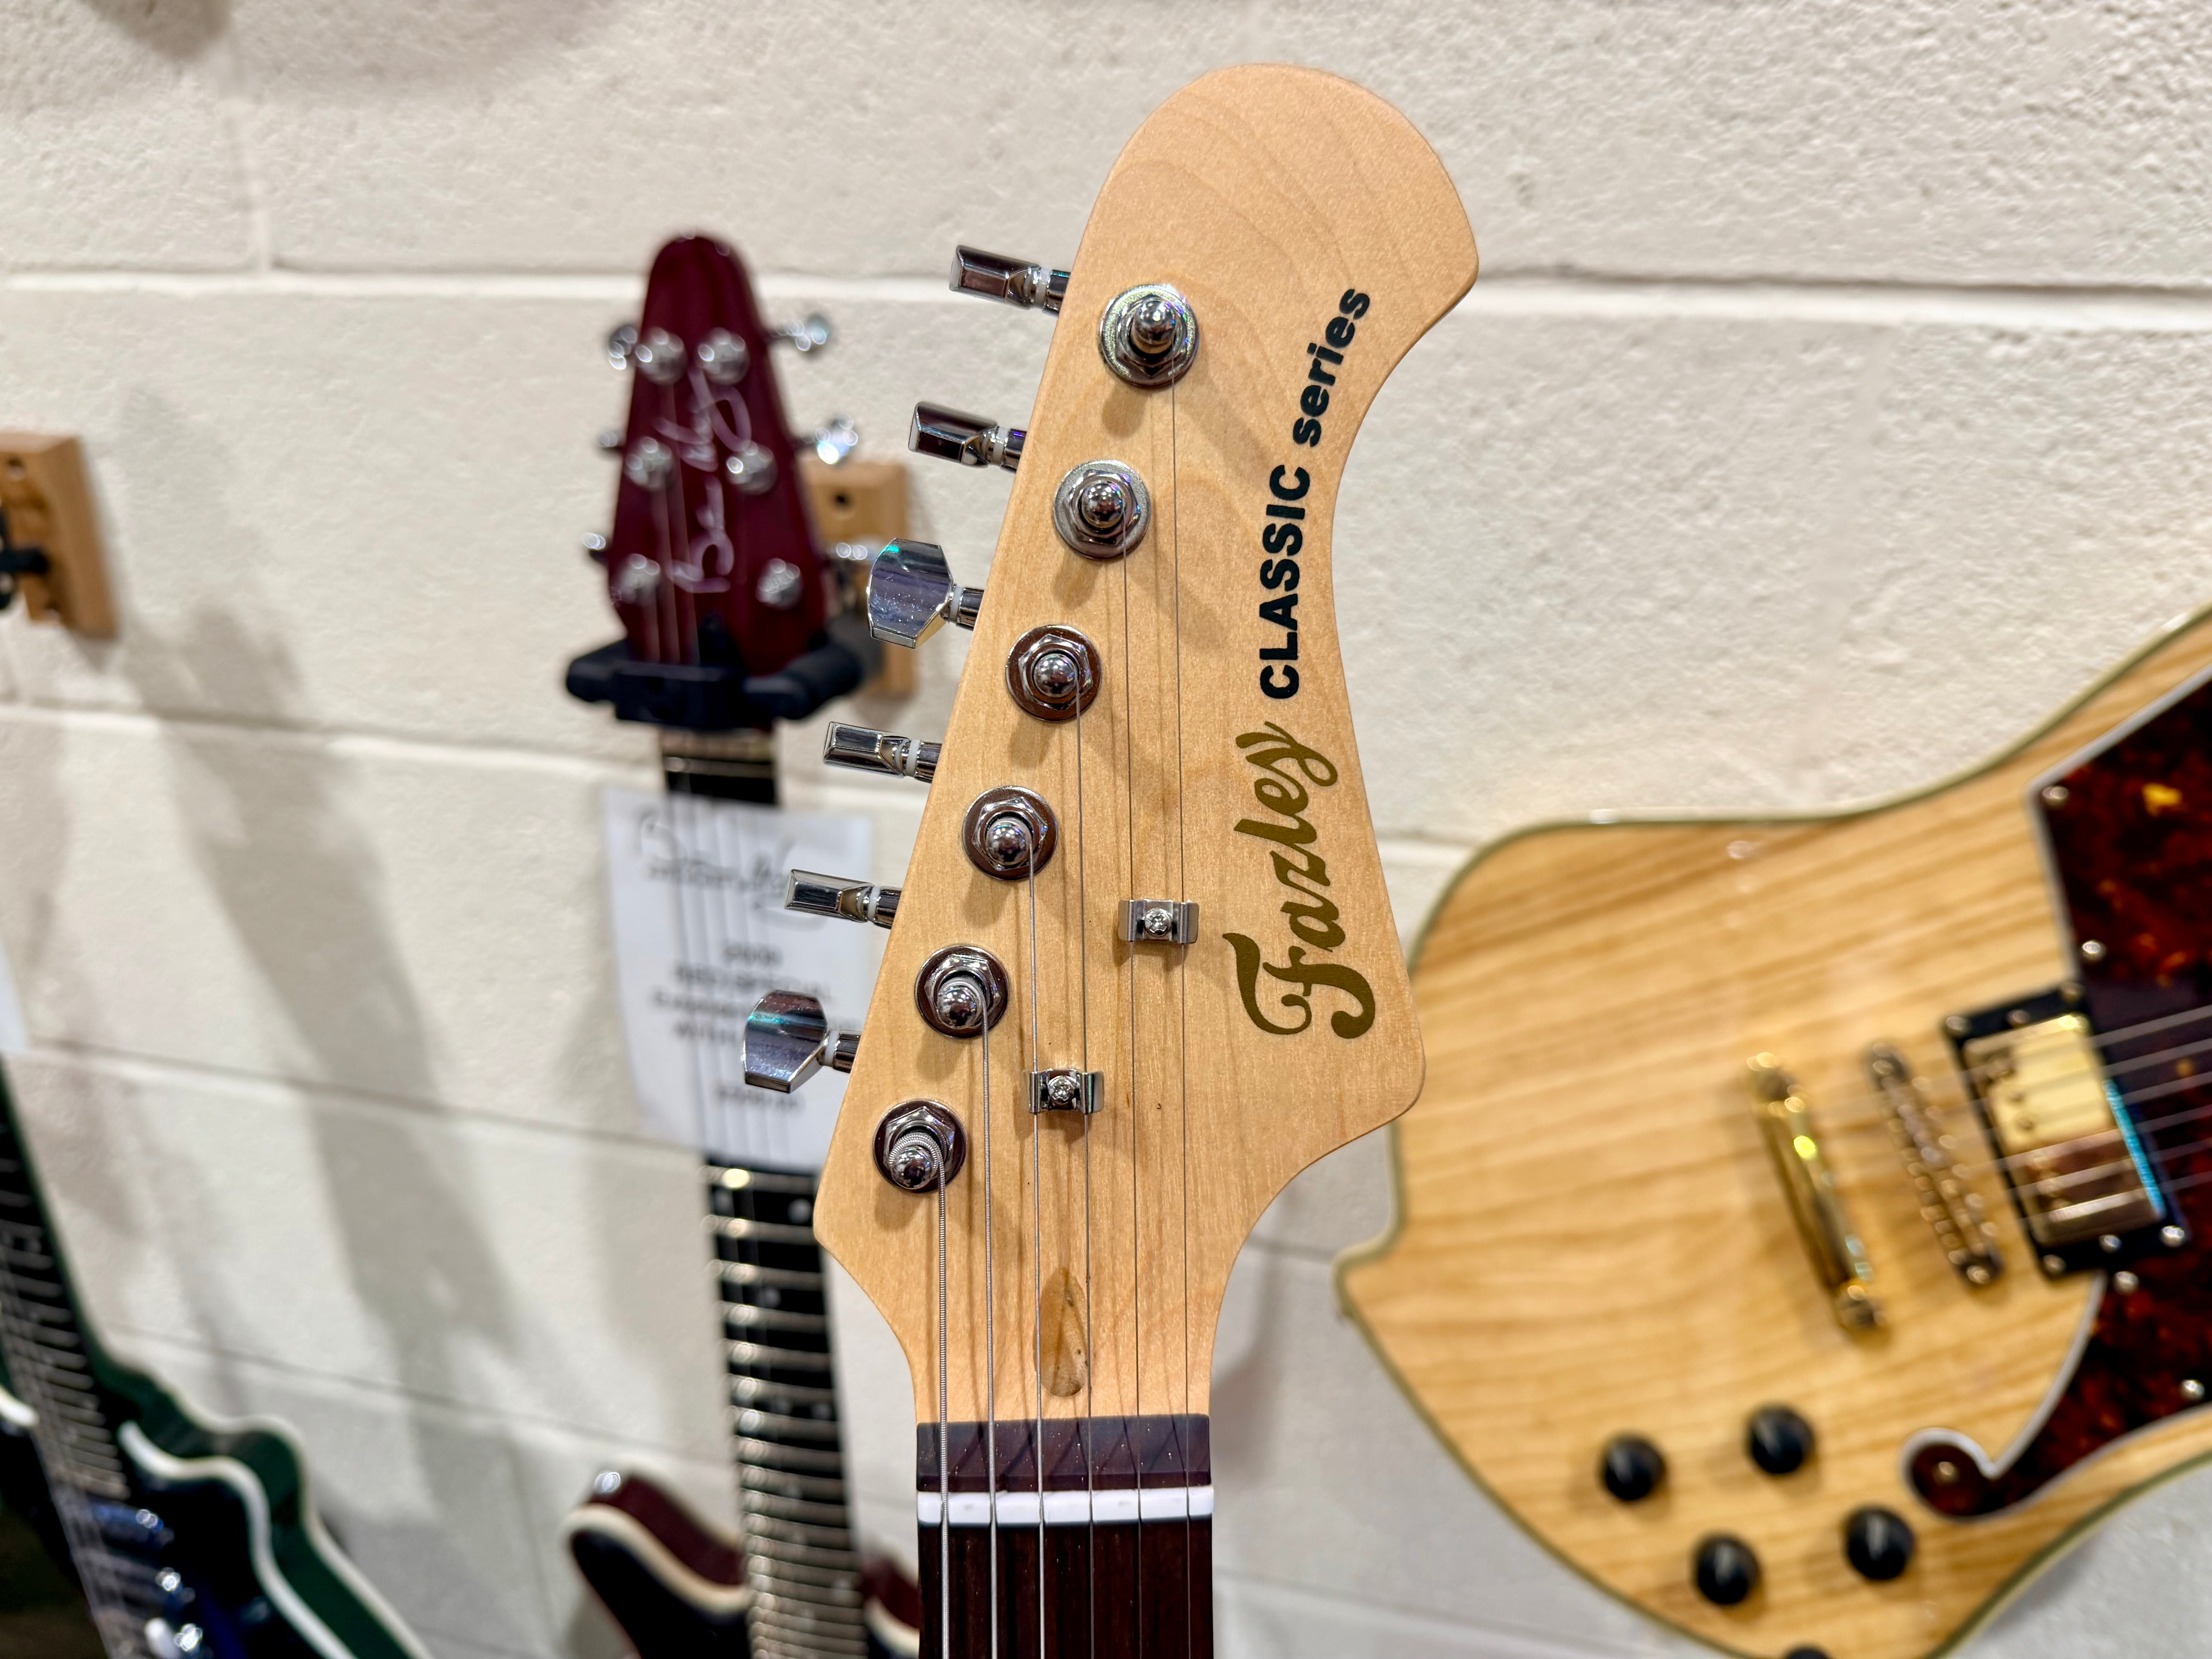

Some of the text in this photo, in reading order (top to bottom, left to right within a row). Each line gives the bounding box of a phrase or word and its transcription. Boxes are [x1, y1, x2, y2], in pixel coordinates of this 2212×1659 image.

[1222, 288, 1376, 1040] Fazley CLASSIC series
